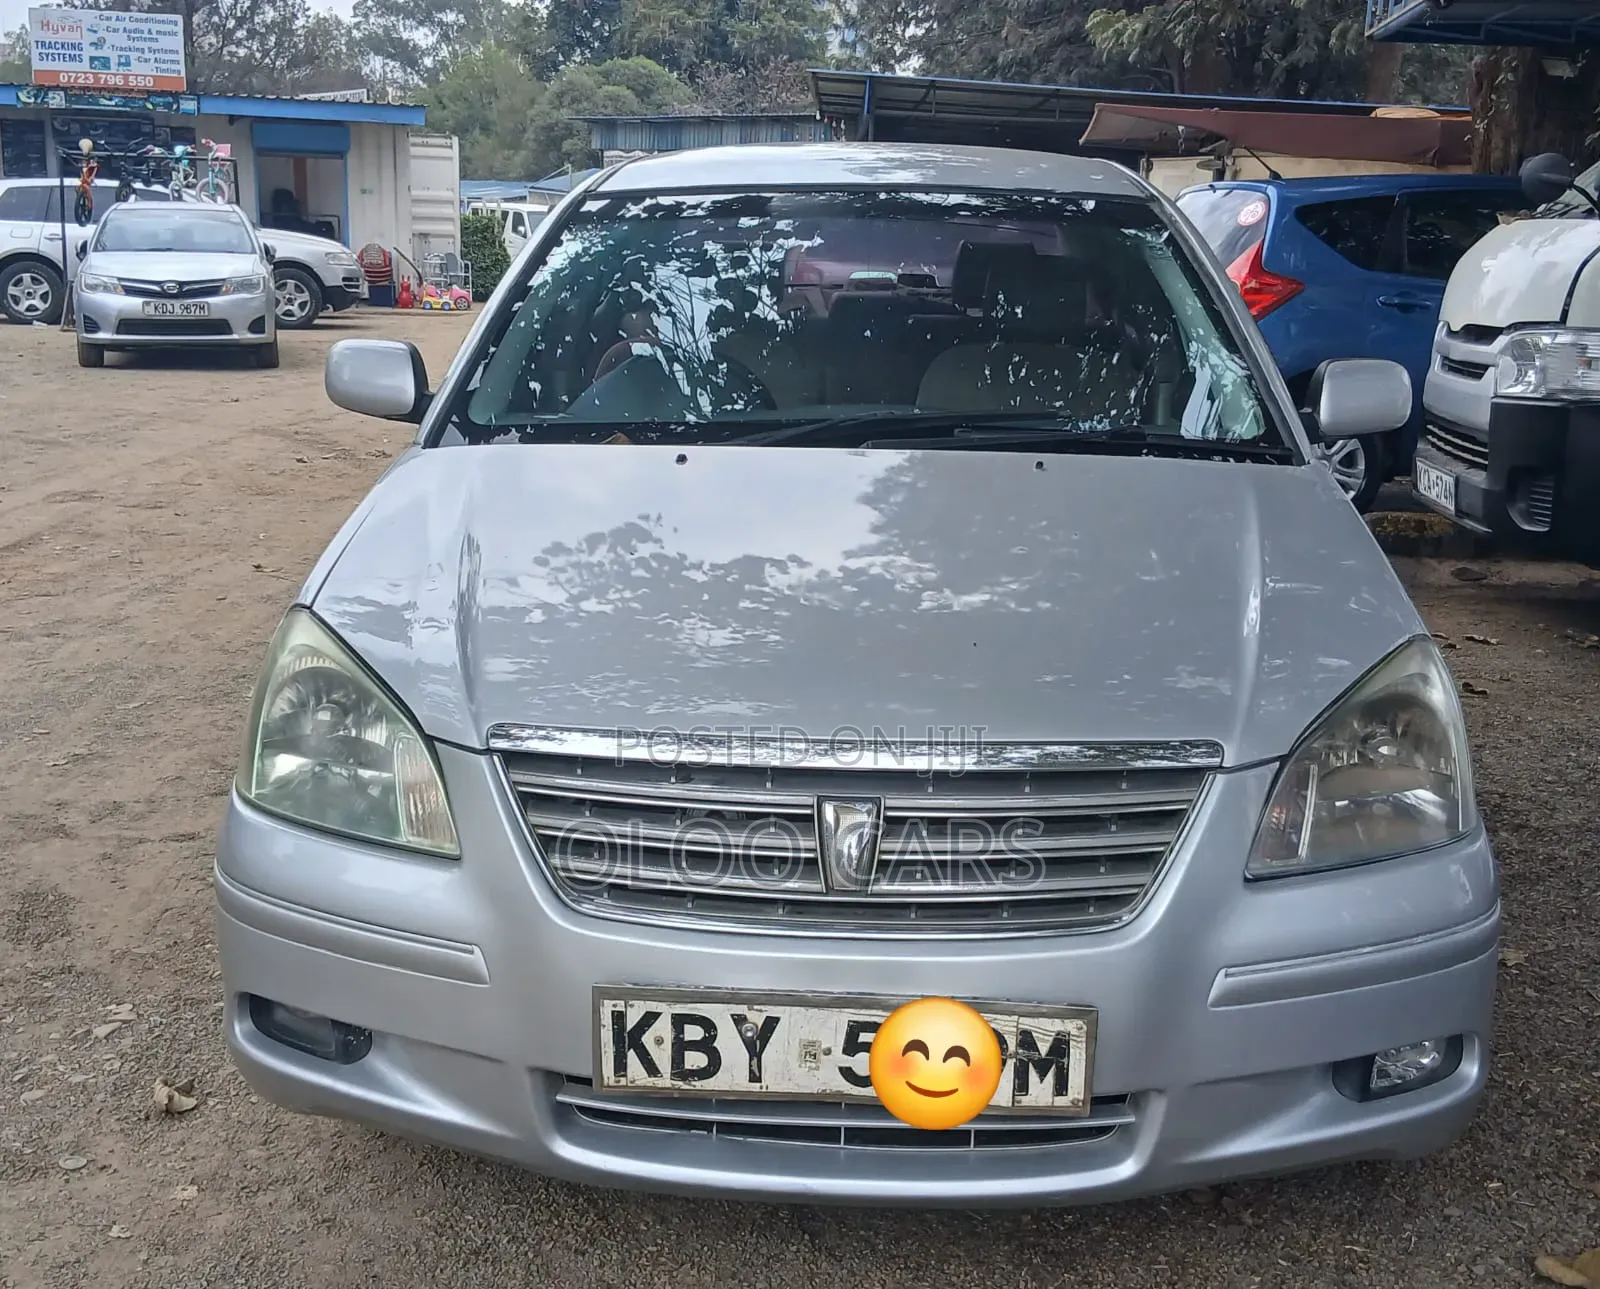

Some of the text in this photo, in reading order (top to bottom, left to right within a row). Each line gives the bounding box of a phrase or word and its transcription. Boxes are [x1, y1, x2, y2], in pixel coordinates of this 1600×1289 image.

[129, 16, 178, 26] Conditioning
[122, 26, 145, 35] Audio
[126, 34, 159, 43] Systems
[34, 40, 83, 51] TRACKING
[147, 46, 179, 55] Systems
[38, 52, 83, 63] SYSTEMS
[154, 57, 180, 65] Alarms
[59, 72, 154, 87] 0723 796 550
[154, 303, 175, 314] KDJ
[611, 1010, 781, 1084] KBY
